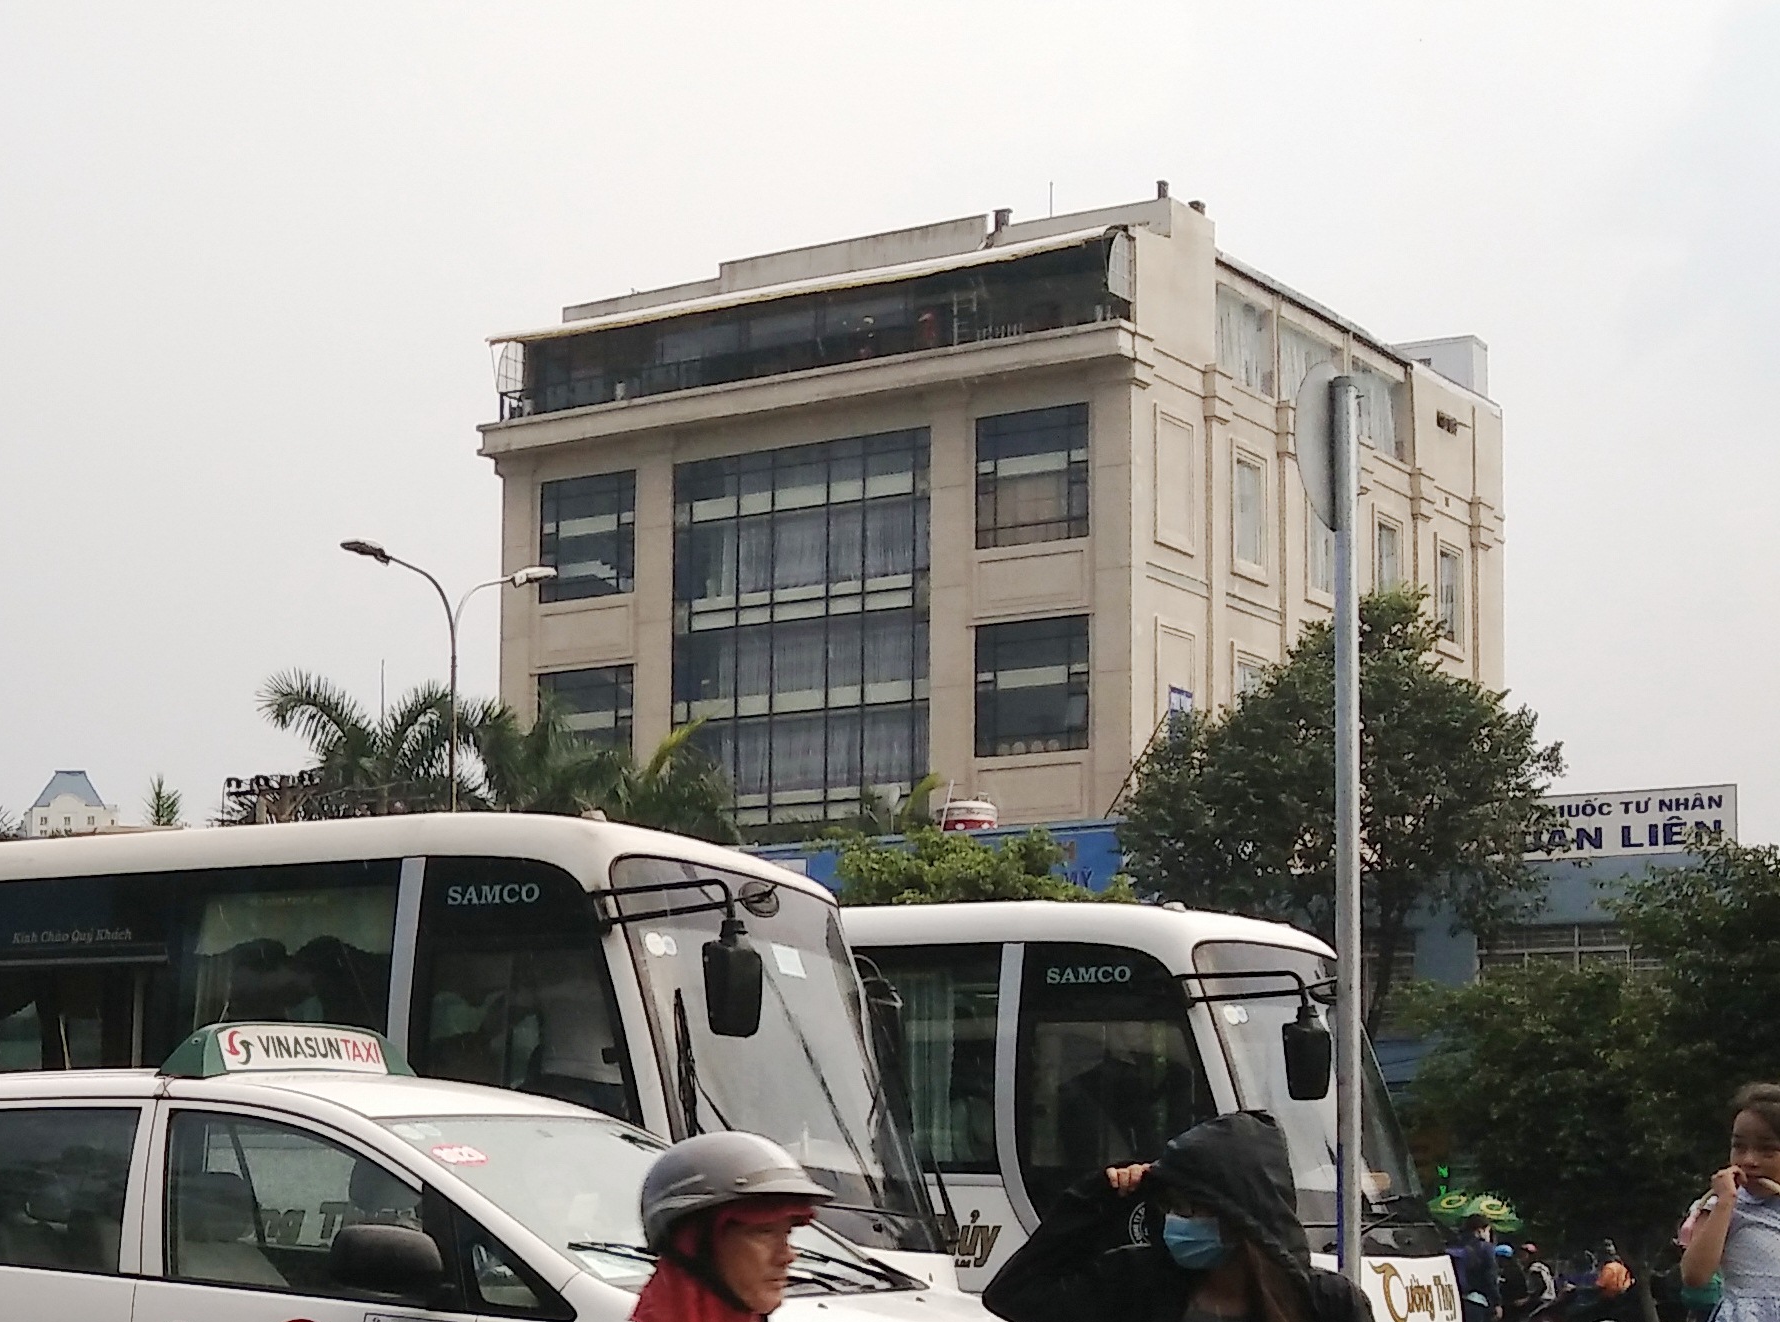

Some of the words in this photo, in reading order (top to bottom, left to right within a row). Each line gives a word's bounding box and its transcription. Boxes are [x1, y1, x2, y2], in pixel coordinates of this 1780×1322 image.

[1620, 796, 1652, 815] TƯ
[1658, 793, 1723, 812] NHÂN
[1621, 816, 1722, 848] LIÊN
[447, 883, 540, 905] SAMCO
[1046, 965, 1132, 984] SAMCO
